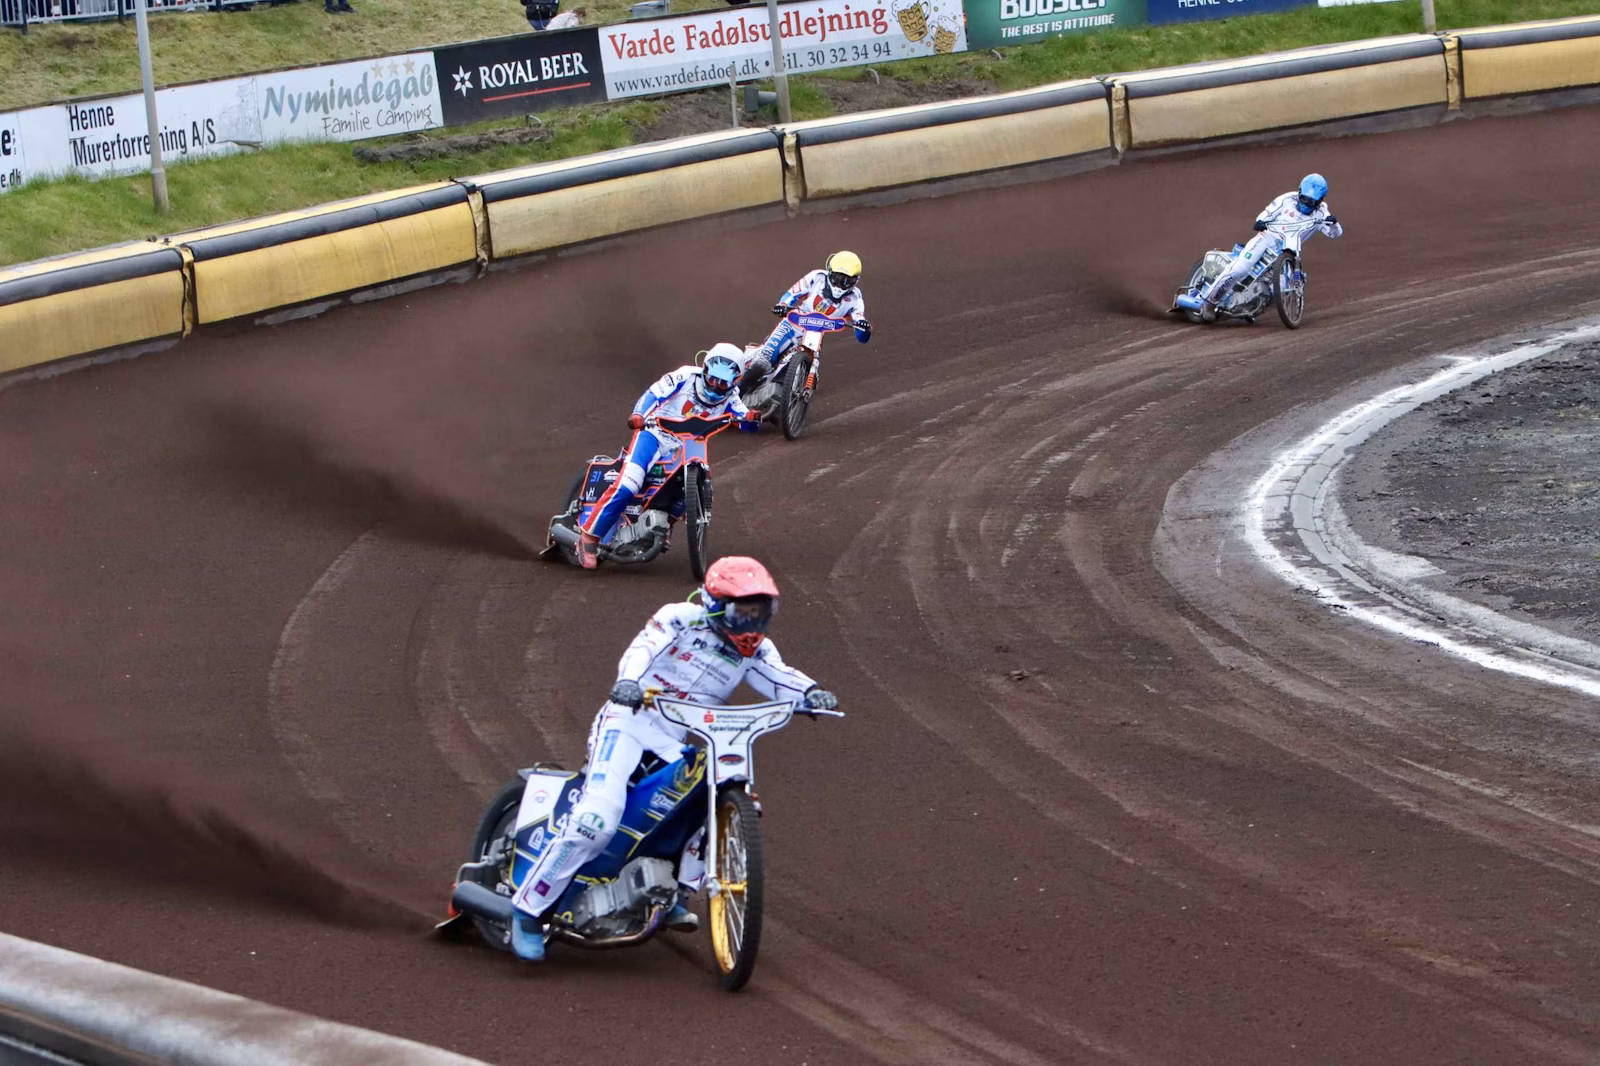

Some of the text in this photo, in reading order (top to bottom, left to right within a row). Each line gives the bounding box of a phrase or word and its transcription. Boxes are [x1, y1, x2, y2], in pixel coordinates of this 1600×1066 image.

[1001, 13, 1115, 38] THE REST IS ATTITUDE
[608, 28, 676, 60] Varde
[479, 52, 589, 90] ROYAL BEER
[614, 41, 892, 93] www.vardefadoe.dk il. 30 32 34 94
[263, 63, 433, 124] Nymindegab
[69, 105, 115, 132] Henne
[321, 103, 432, 136] Familie Camping
[73, 118, 216, 166] Murerforrening A/S
